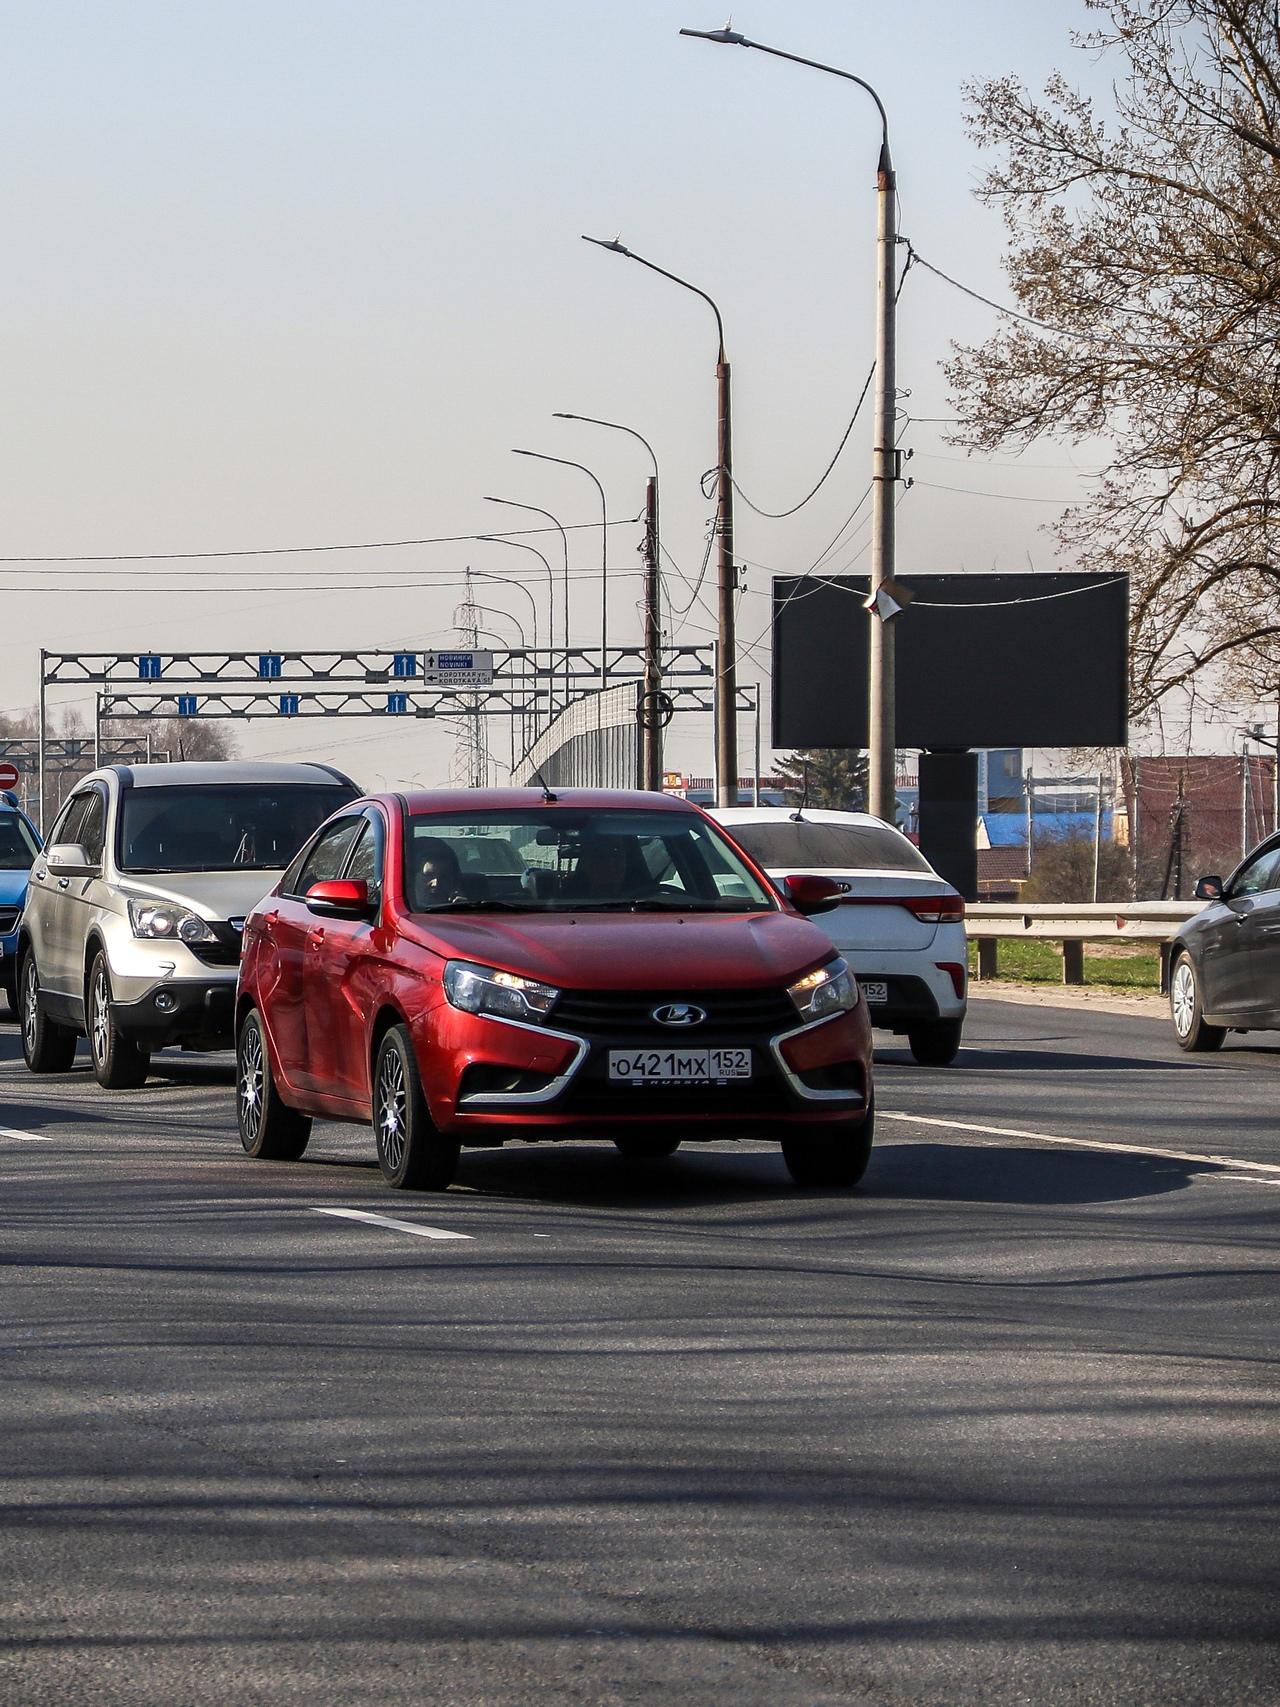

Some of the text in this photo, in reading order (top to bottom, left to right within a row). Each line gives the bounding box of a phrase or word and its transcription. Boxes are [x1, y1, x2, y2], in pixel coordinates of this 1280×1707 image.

[862, 984, 882, 994] 152
[616, 1053, 706, 1076] О421МХ
[712, 1051, 745, 1068] 152
